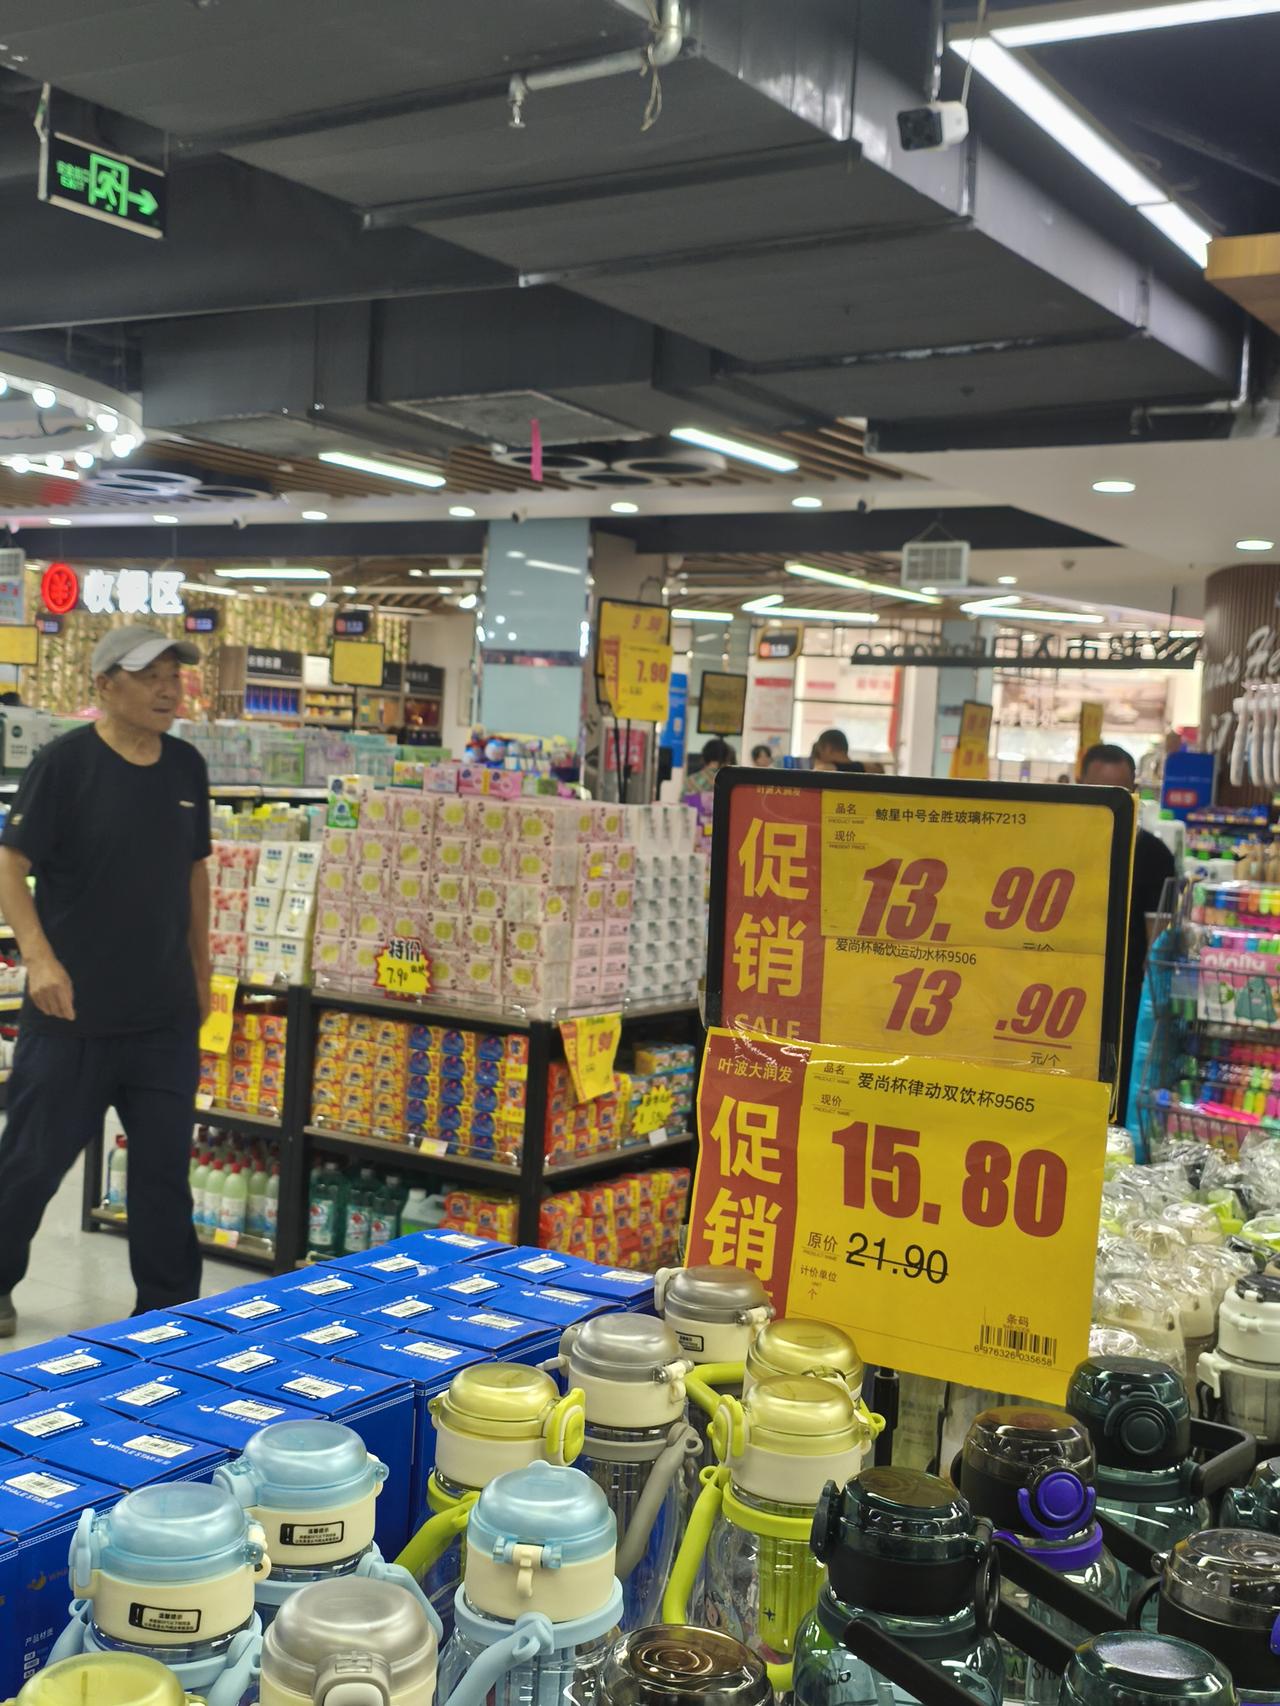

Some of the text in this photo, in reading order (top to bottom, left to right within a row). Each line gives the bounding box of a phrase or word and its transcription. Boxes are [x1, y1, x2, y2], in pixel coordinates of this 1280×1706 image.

[835, 803, 857, 815] 品名
[875, 808, 1027, 825] 鲸星中号金胜玻璃杯7213
[834, 830, 856, 842] 现价
[389, 940, 421, 962] 特价
[834, 938, 977, 966] 爱尚杯畅饮运动水杯9506
[1030, 1052, 1061, 1067] 元/个
[718, 1057, 793, 1084] 叶波大润发
[823, 1063, 845, 1076] 品名
[820, 1094, 843, 1108] 现价
[857, 1072, 1036, 1113] 爱尚杯律动双饮杯9565
[807, 1231, 839, 1253] 原价
[846, 1232, 949, 1284] 21.90
[800, 1264, 838, 1283] 计价单位
